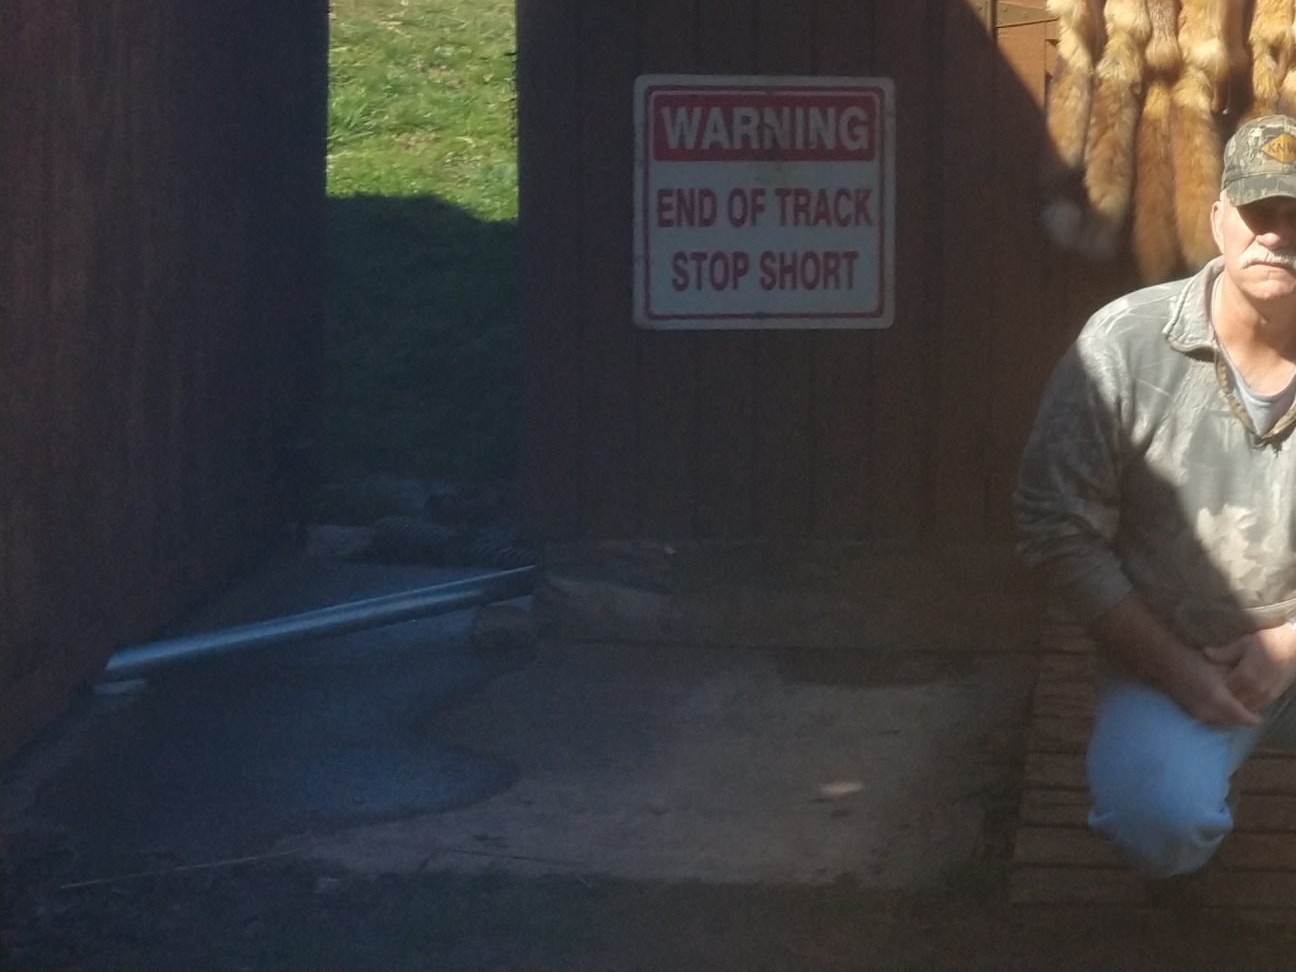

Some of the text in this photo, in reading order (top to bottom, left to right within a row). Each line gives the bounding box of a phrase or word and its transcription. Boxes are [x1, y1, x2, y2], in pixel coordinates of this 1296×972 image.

[661, 106, 870, 151] WARNING
[655, 187, 873, 228] END OF TRACK
[671, 250, 860, 292] STOP SHORT
